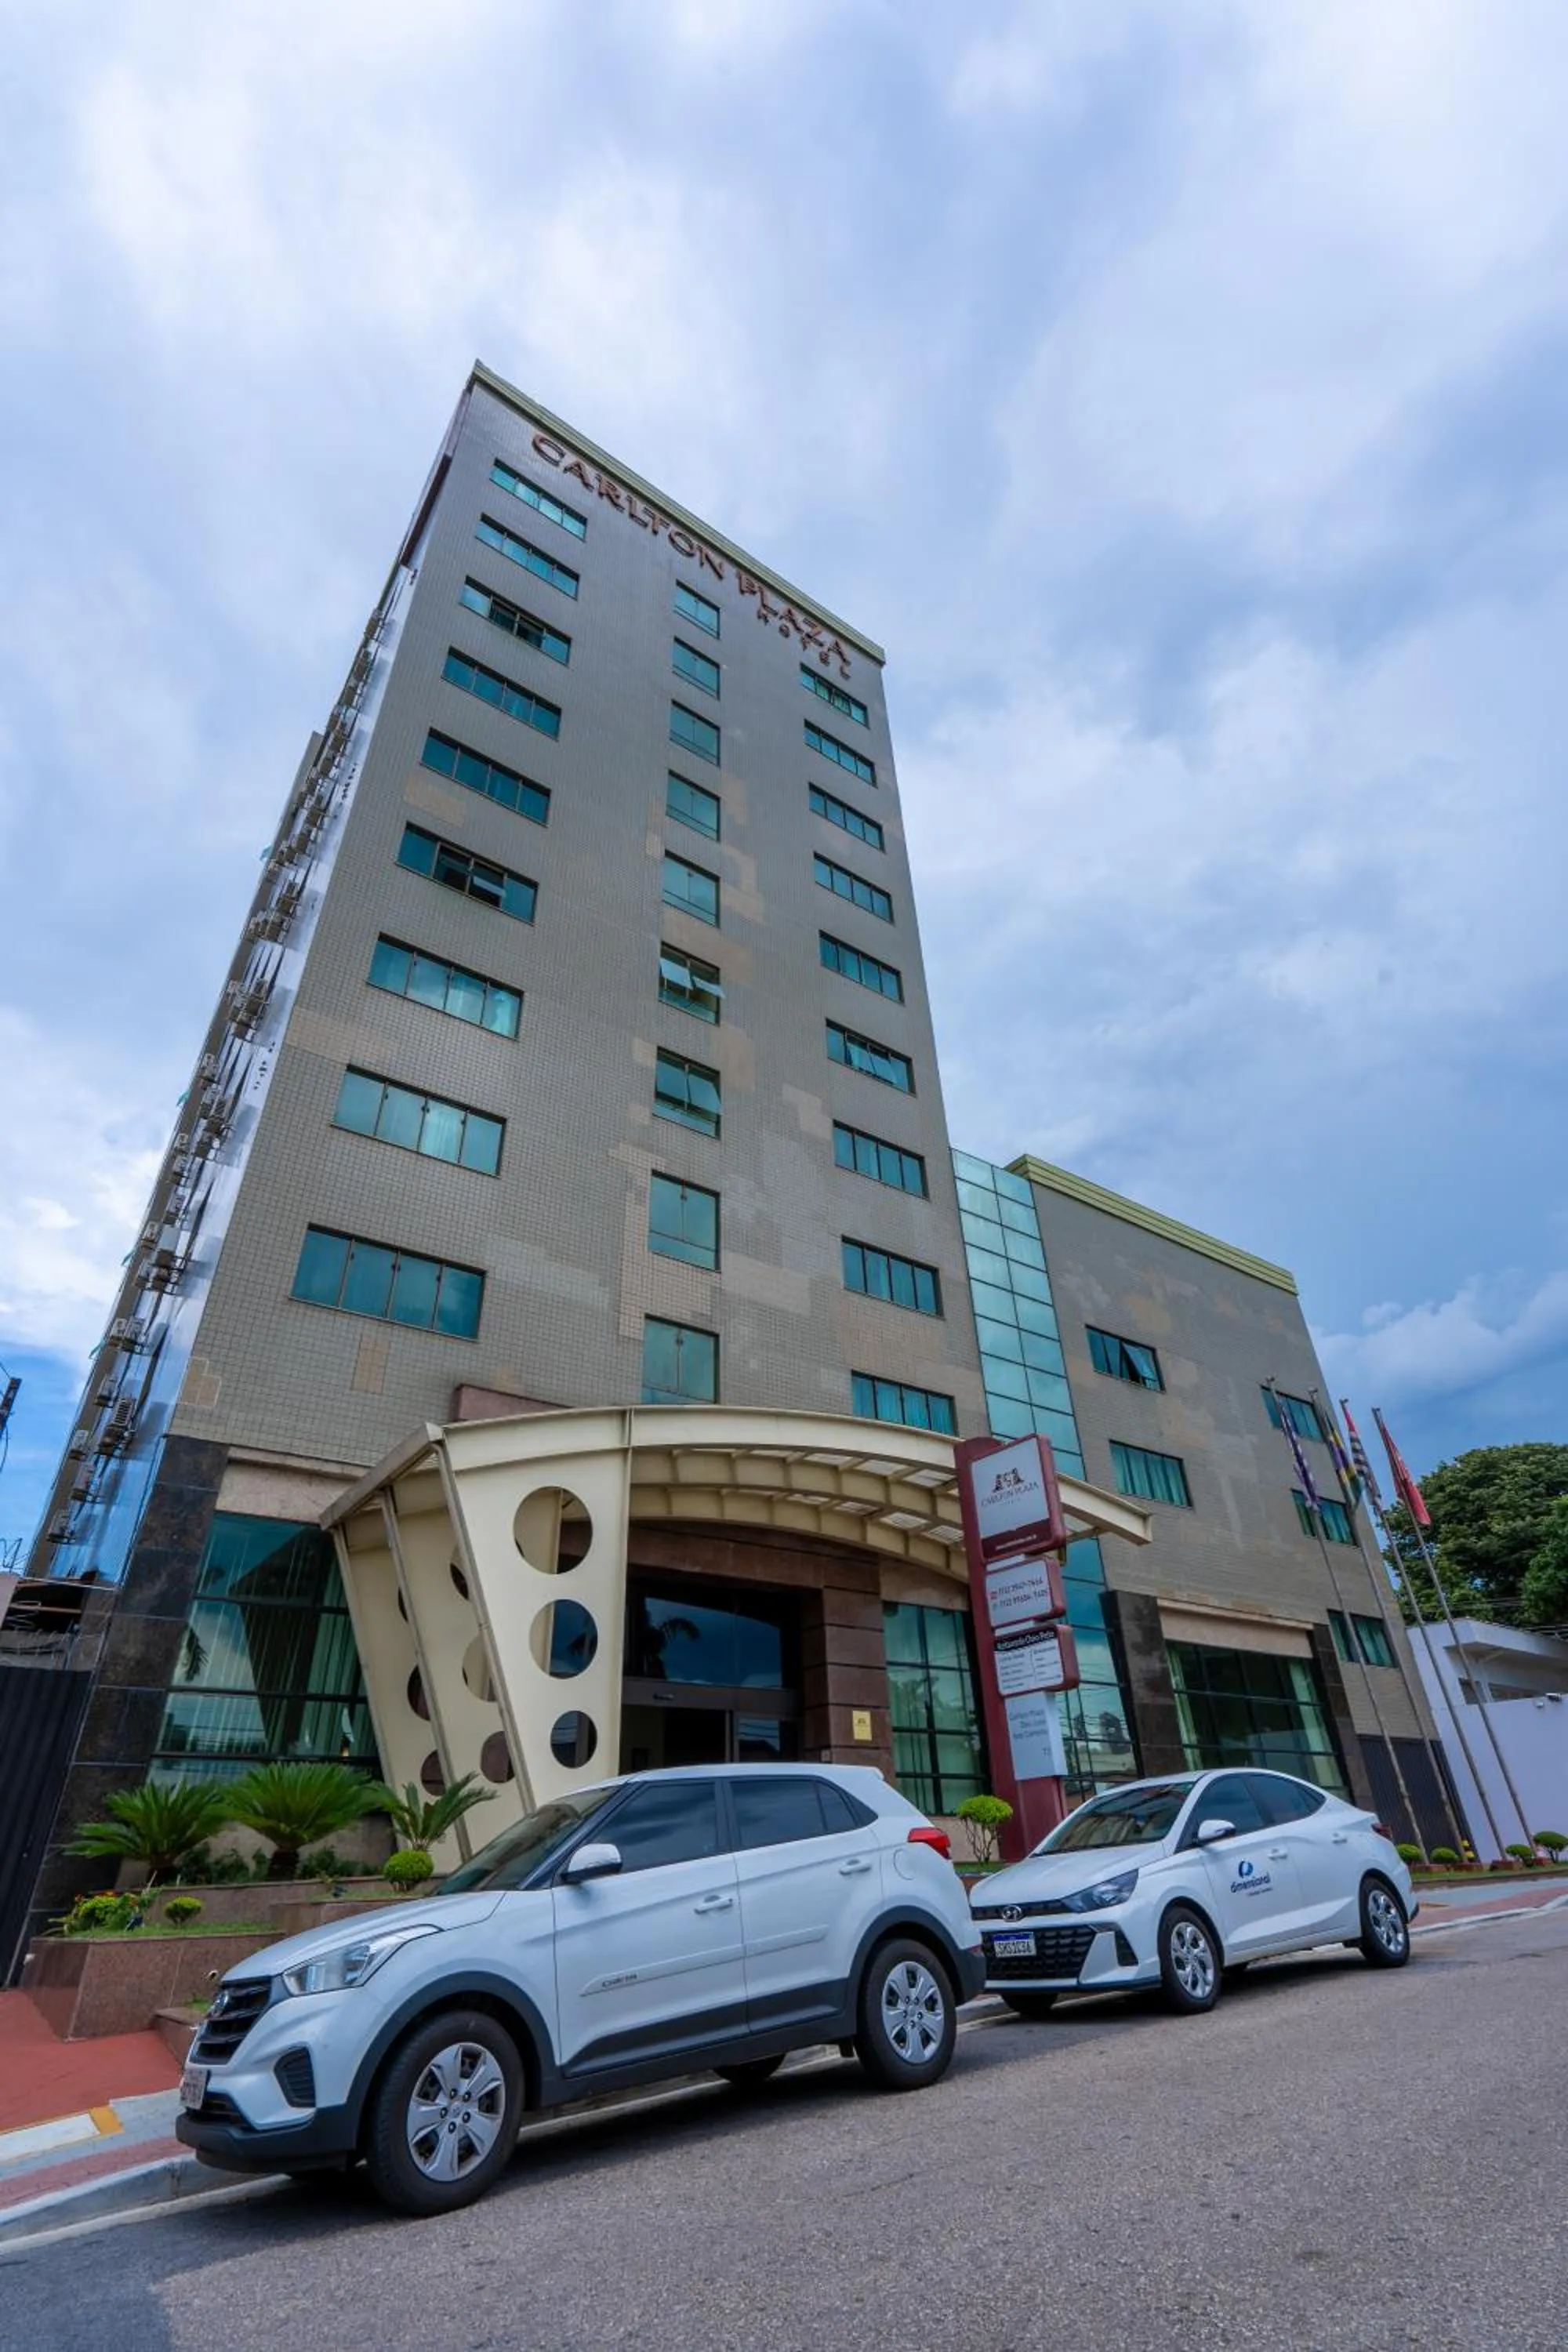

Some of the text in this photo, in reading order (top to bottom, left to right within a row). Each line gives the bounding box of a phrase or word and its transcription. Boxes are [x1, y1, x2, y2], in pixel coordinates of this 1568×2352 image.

[532, 432, 853, 667] CARLTON PLAZA
[757, 608, 852, 681] HOTEL
